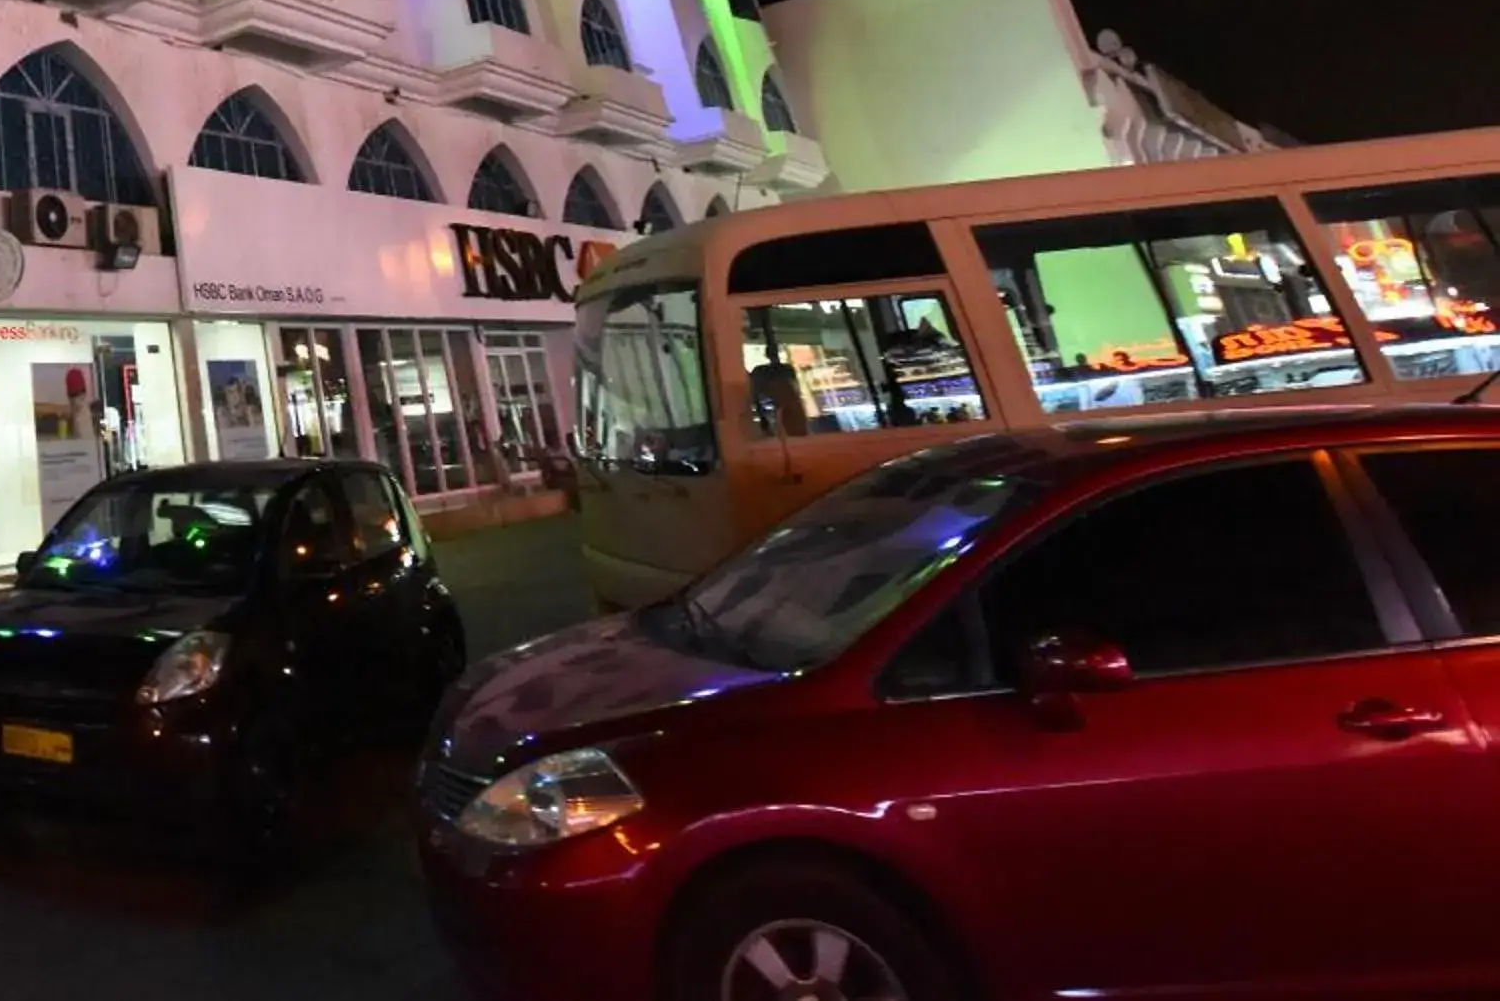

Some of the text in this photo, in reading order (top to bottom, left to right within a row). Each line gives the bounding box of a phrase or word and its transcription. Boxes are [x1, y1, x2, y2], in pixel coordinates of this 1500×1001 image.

[449, 222, 576, 303] HSBC
[193, 282, 229, 300] HSBC
[229, 284, 255, 301] Bank
[256, 285, 285, 302] Oman
